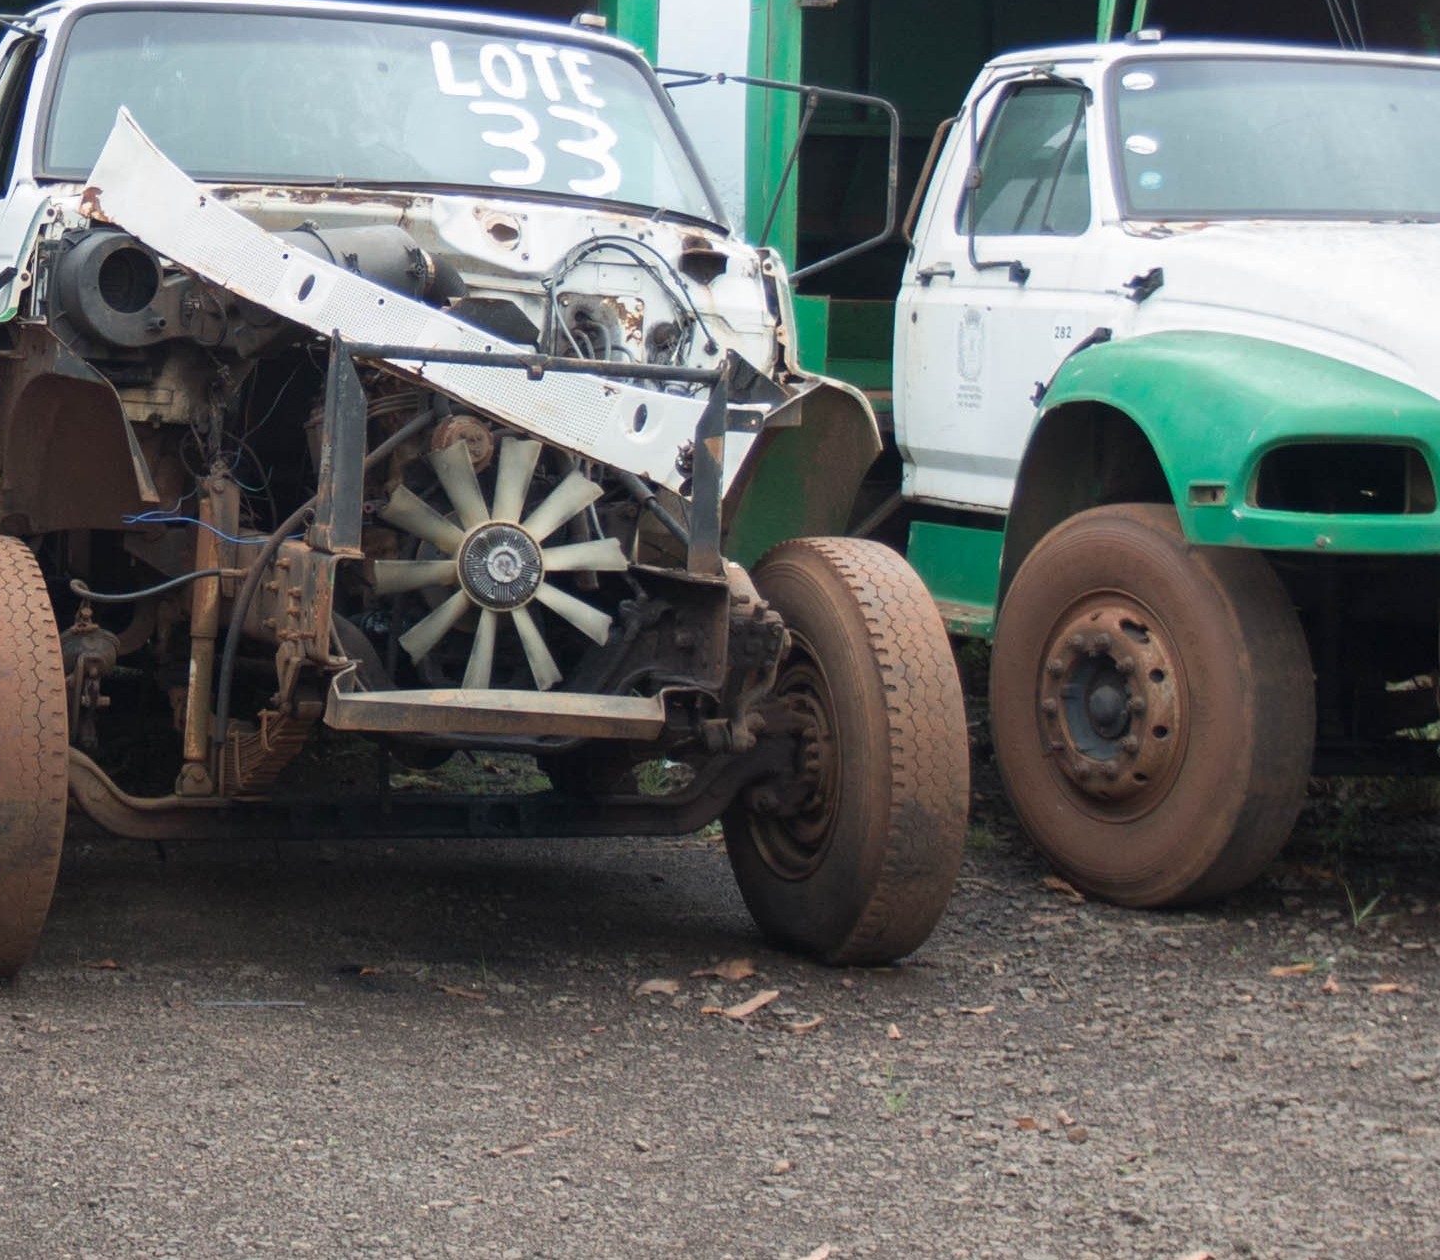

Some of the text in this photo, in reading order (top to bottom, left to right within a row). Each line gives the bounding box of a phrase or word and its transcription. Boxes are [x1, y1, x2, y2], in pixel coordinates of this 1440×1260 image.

[431, 40, 605, 108] LOTE
[469, 101, 620, 198] 33
[1054, 326, 1072, 340] 282
